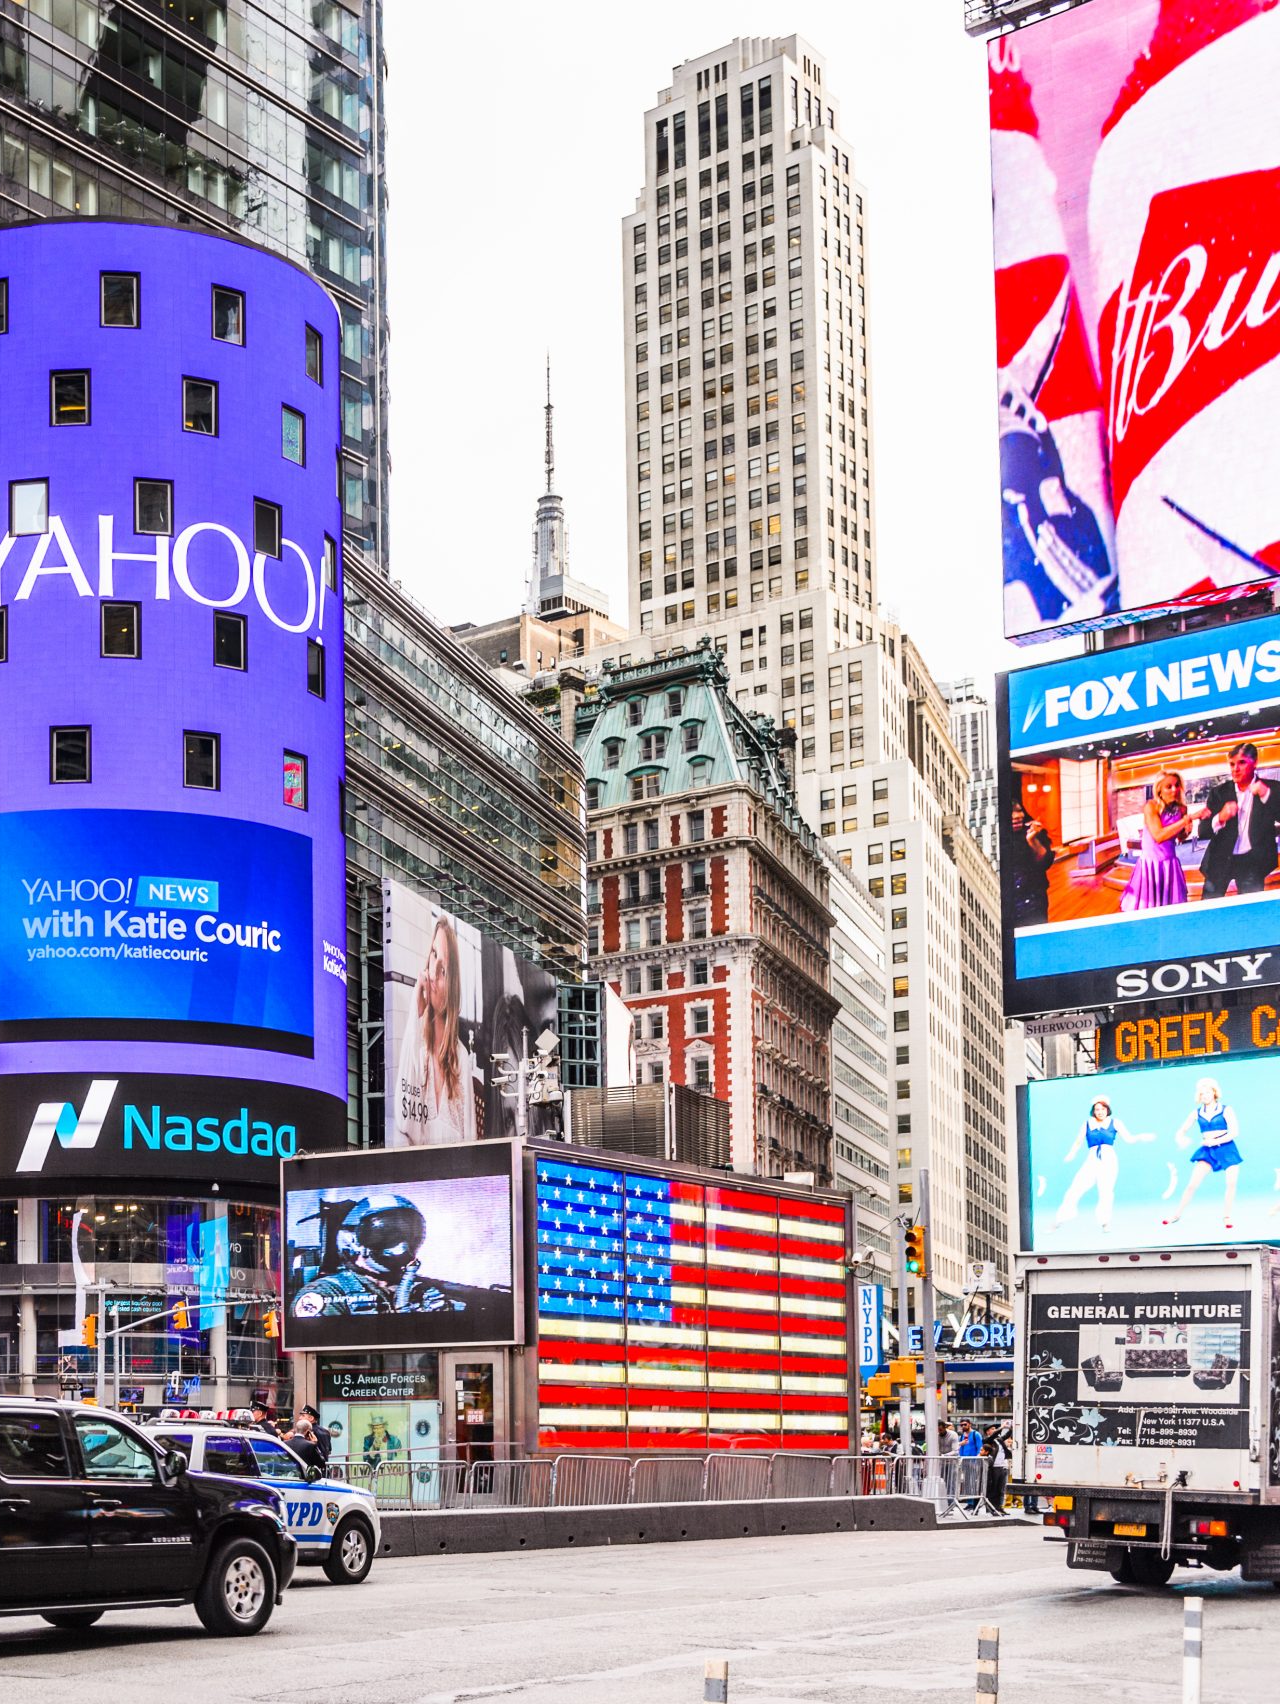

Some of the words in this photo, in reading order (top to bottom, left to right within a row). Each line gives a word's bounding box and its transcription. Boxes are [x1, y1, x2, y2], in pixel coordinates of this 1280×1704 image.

[1045, 671, 1139, 728] FOX
[1145, 640, 1280, 707] NEWS
[21, 878, 133, 905] YAHOO!
[148, 884, 209, 904] NEWS
[23, 909, 94, 939] with
[104, 910, 187, 940] Katie
[195, 914, 282, 952] Couric
[27, 943, 209, 962] yahoo.com/katiecouric
[1116, 953, 1272, 997] SONY
[1026, 1019, 1093, 1035] SHERWOOD
[1115, 1010, 1230, 1063] GREEK
[1251, 1005, 1280, 1048] C
[401, 1097, 429, 1124] $14.99
[1047, 1306, 1129, 1319] GENERAL
[1134, 1304, 1242, 1319] FURNITURE
[862, 1288, 873, 1363] NYPD
[333, 1374, 354, 1385] U.S.
[358, 1373, 388, 1384] ARMED
[390, 1372, 426, 1384] FORCES
[341, 1386, 376, 1397] CAREER
[379, 1385, 414, 1397] CENTER
[467, 1414, 484, 1423] OPEN
[1159, 1417, 1175, 1425] York
[286, 1502, 323, 1526] YPD
